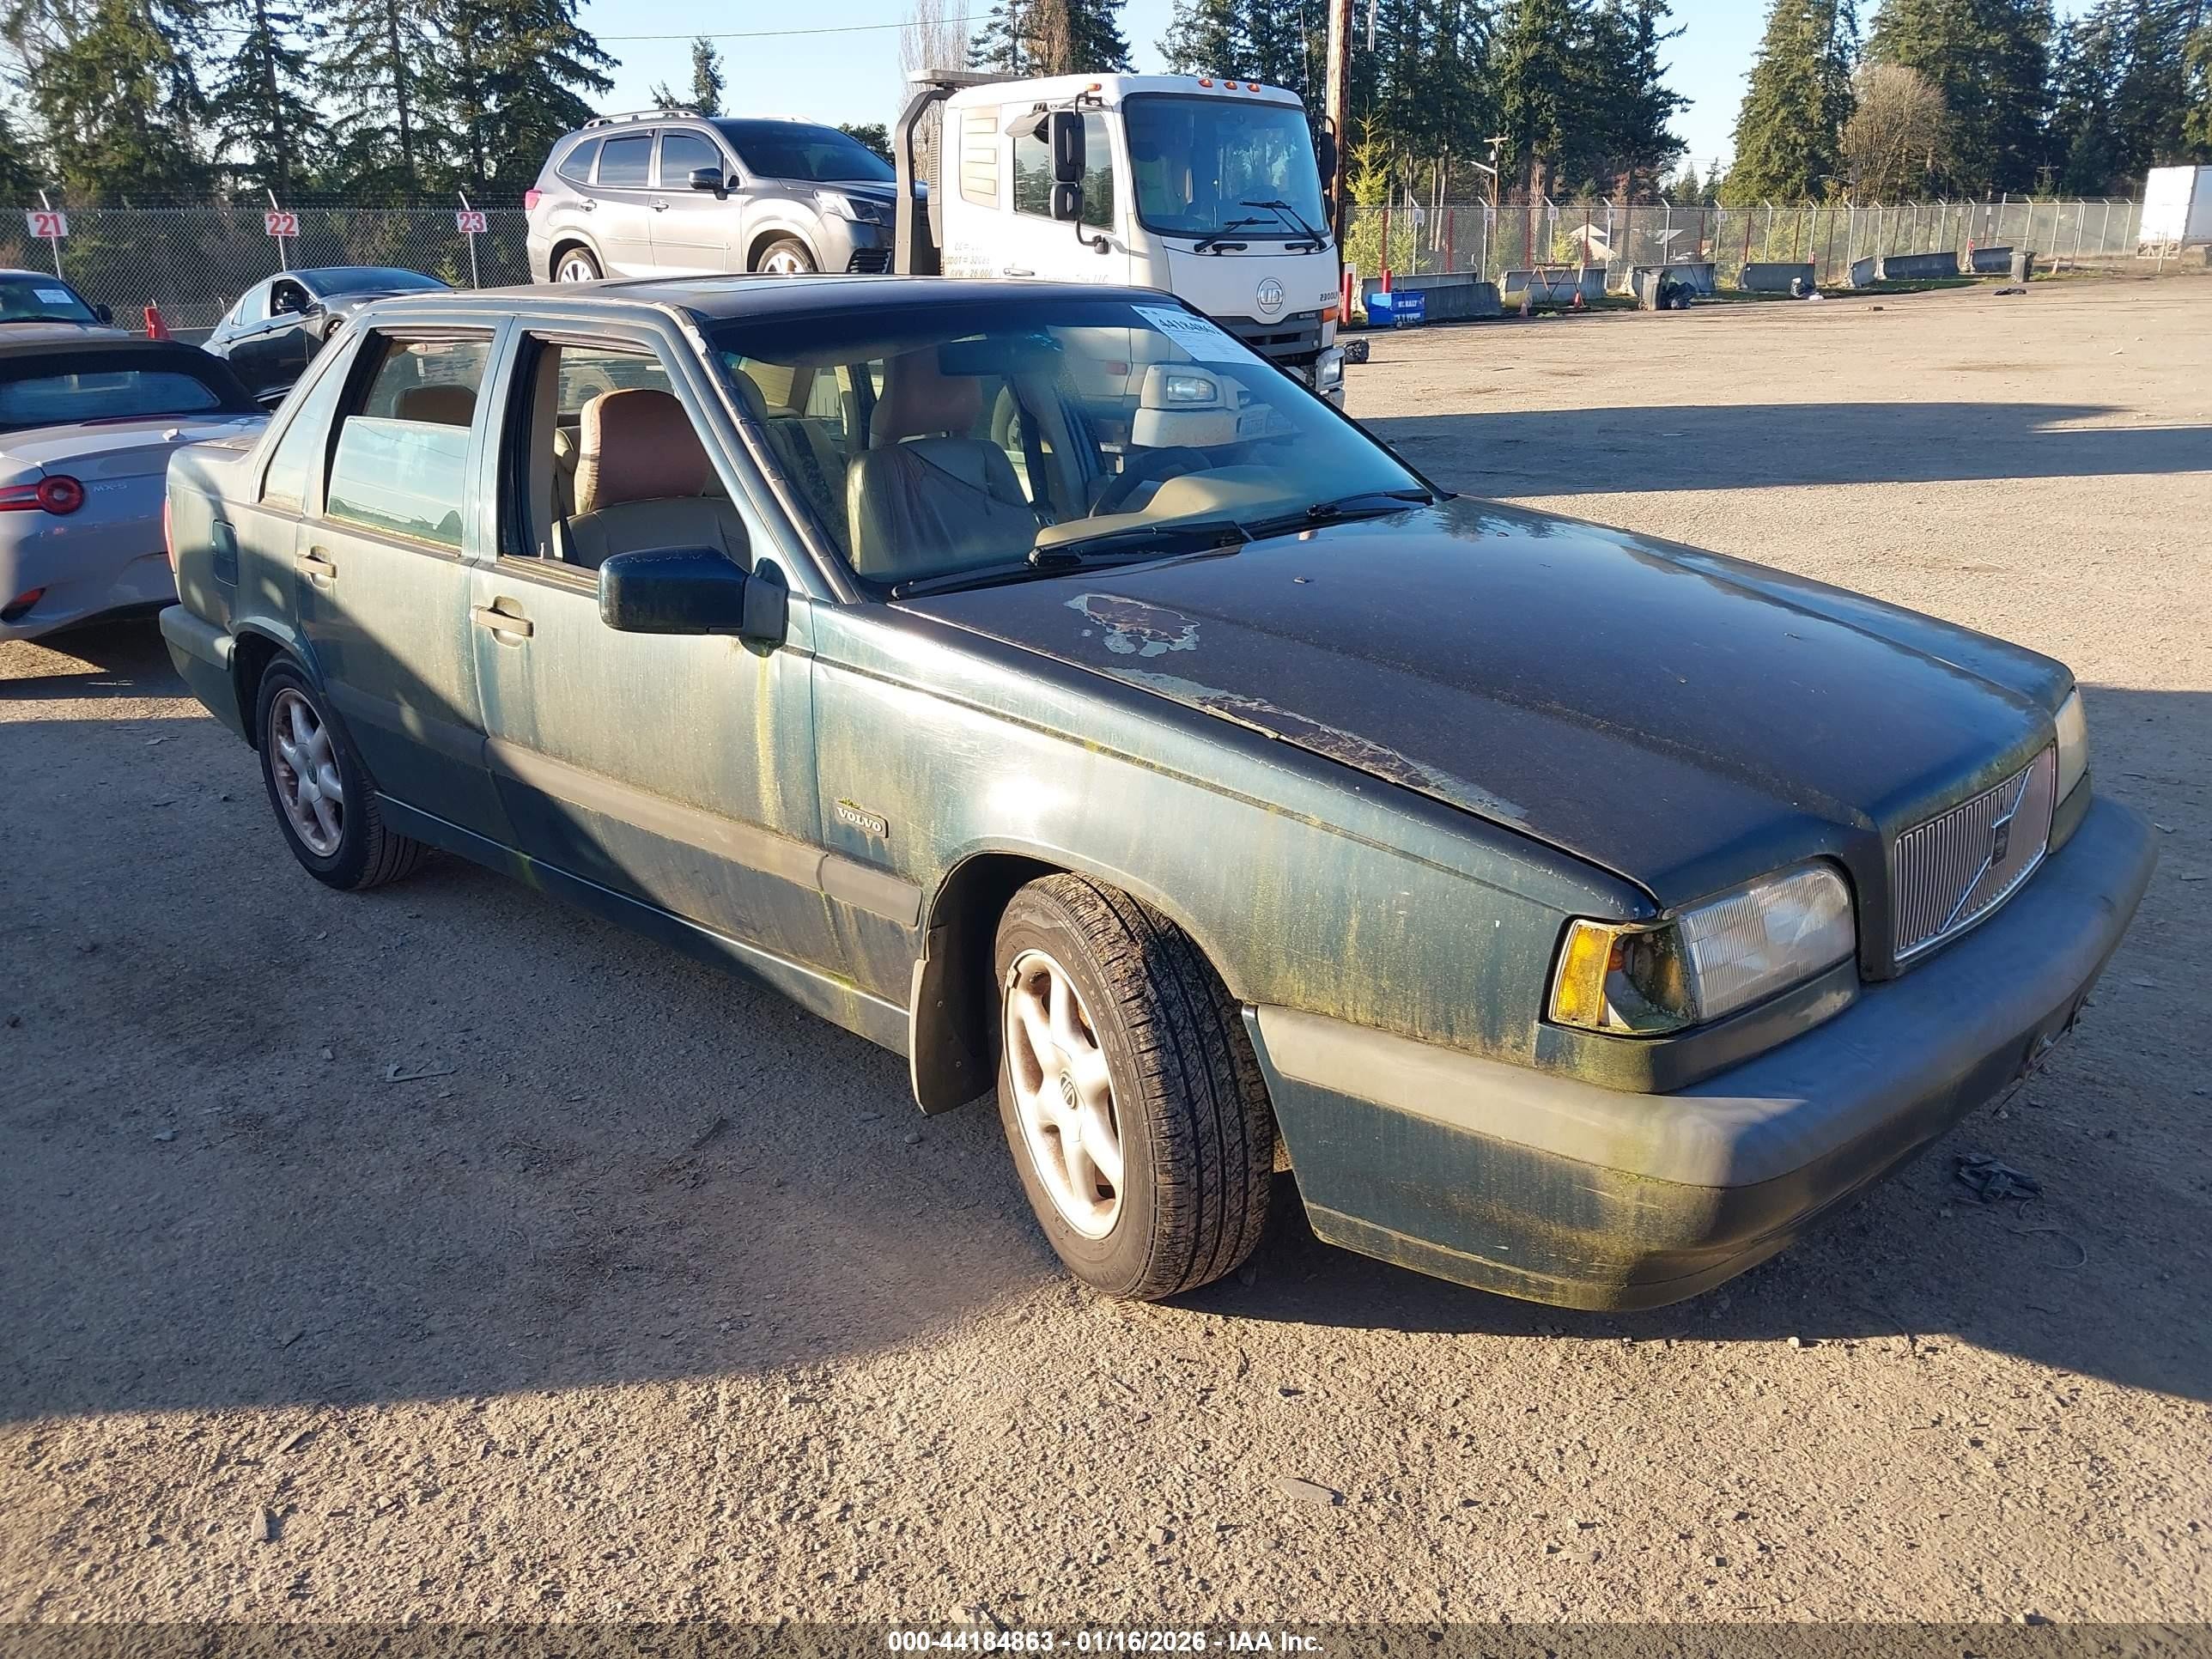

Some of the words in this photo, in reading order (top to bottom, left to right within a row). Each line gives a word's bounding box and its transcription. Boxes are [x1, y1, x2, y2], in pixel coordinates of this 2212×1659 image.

[34, 214, 62, 235] 21
[269, 214, 296, 234] 22
[459, 213, 484, 232] 23
[93, 483, 128, 493] MX-5
[836, 806, 882, 832] VOLVO
